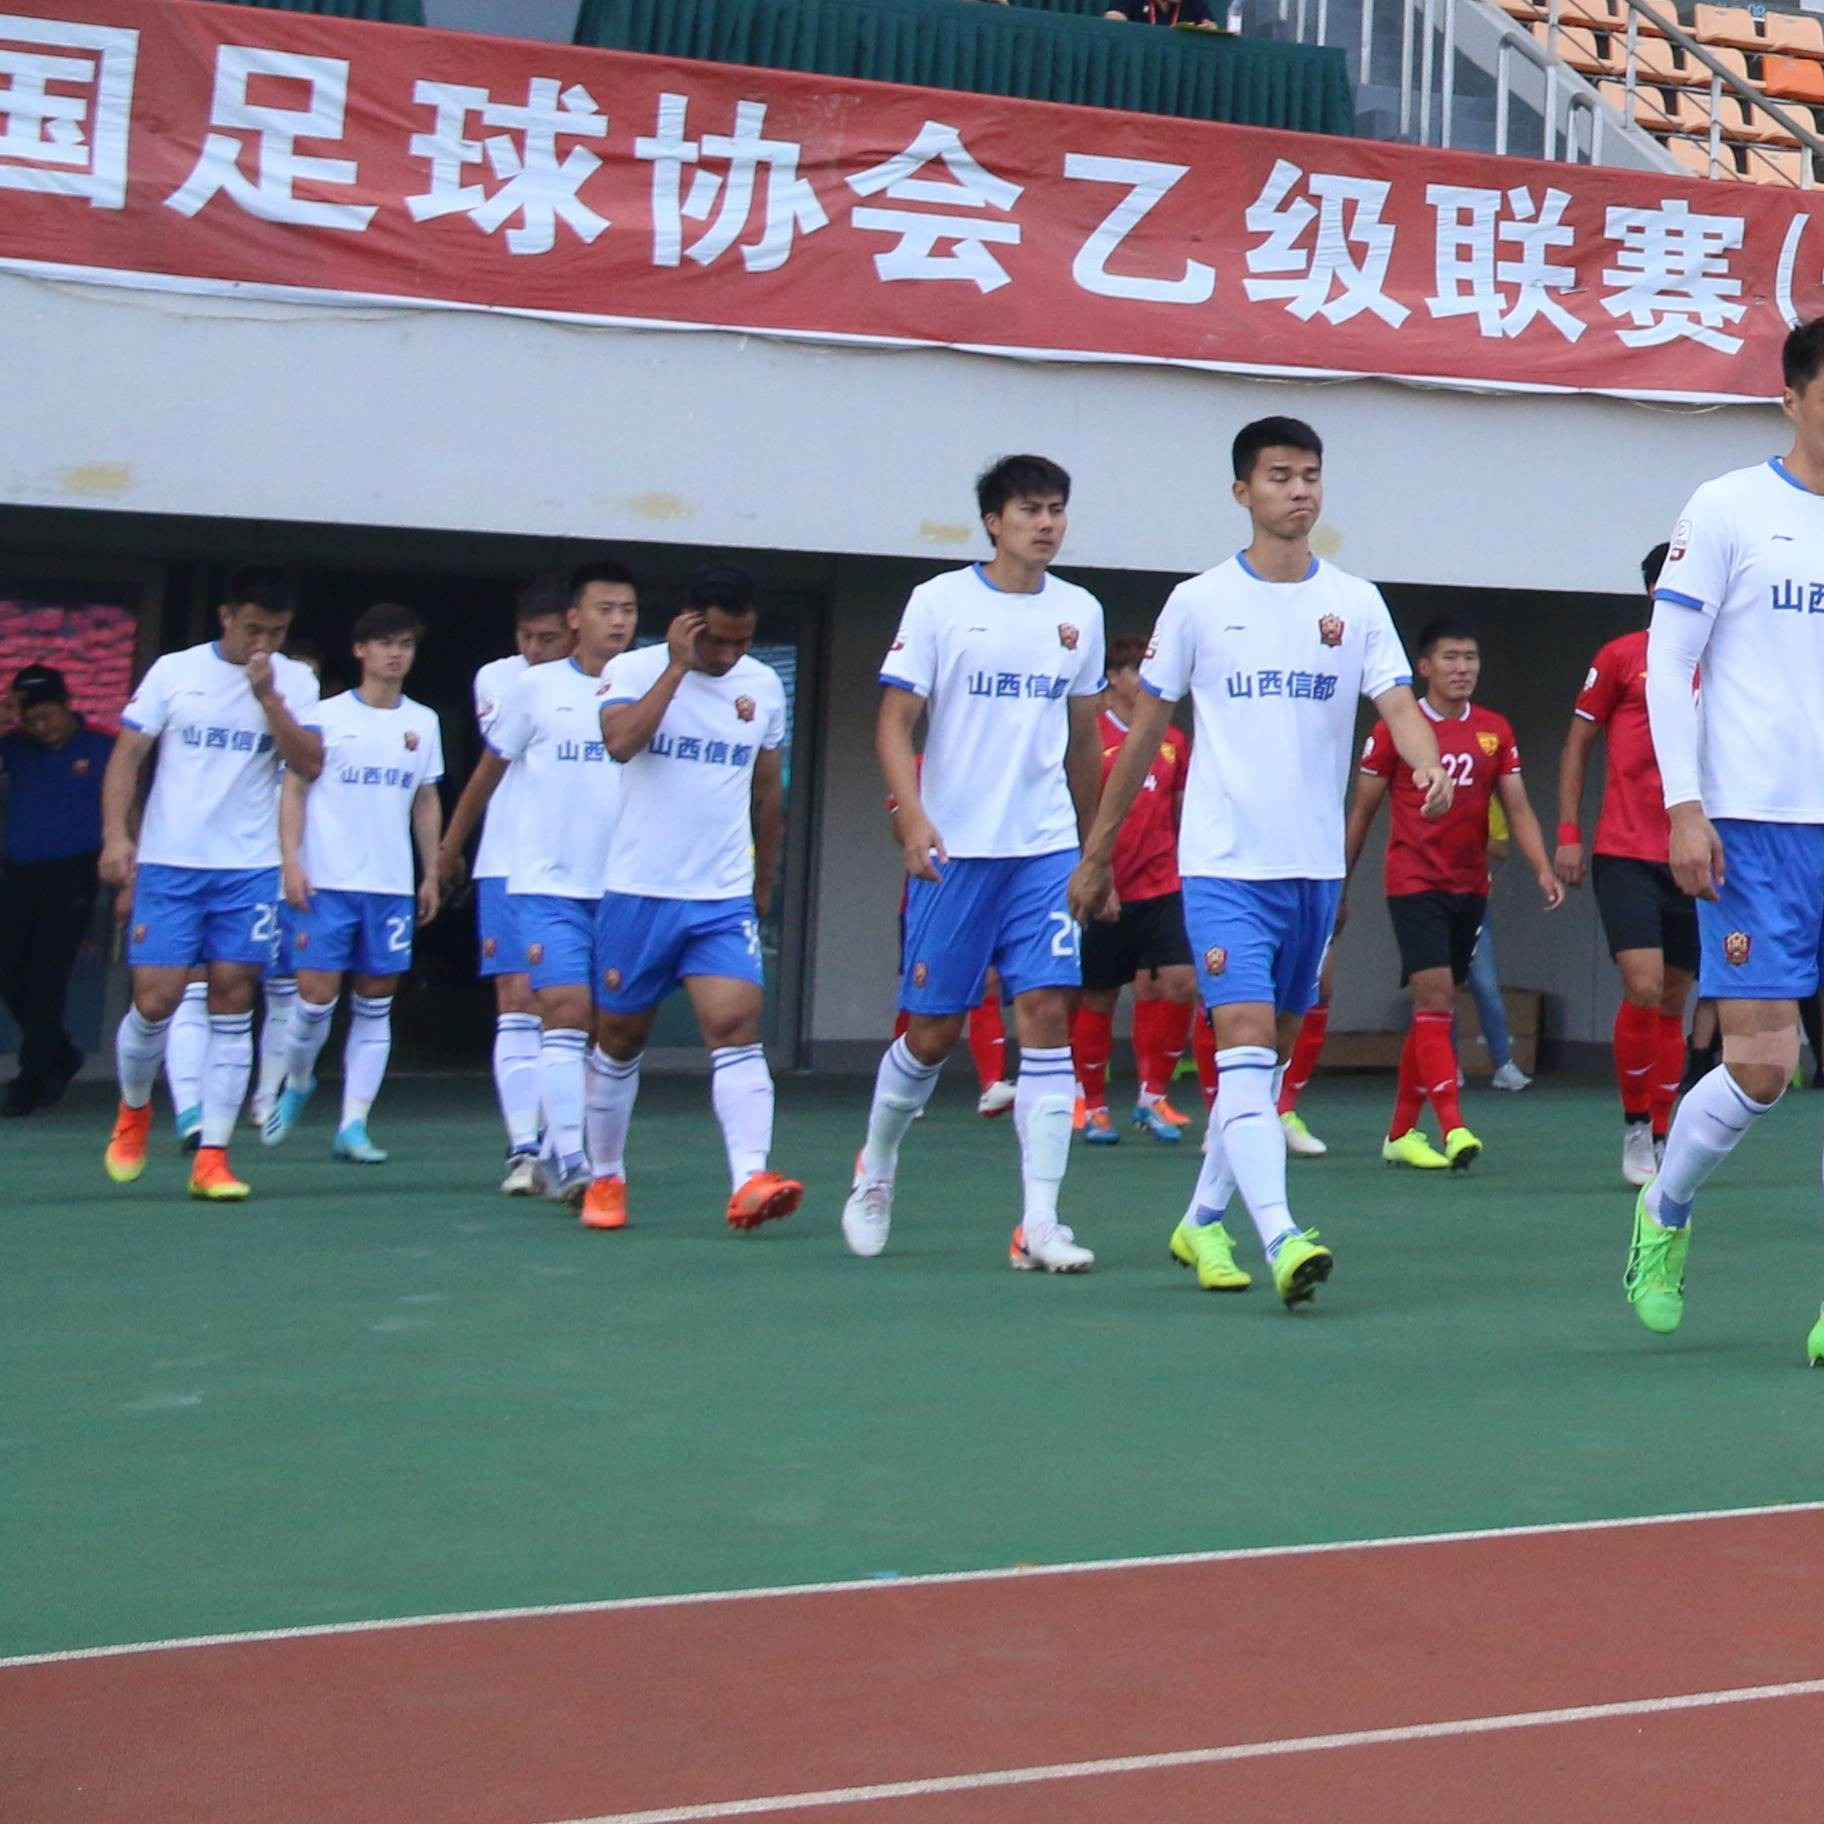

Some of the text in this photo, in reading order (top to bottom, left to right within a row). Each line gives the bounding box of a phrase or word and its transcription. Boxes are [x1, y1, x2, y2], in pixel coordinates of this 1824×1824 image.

[966, 670, 1072, 700] 山西信都
[1225, 669, 1339, 702] 山西信都
[648, 732, 755, 768] 山西信都
[1440, 751, 1474, 787] 22
[250, 902, 282, 942] 2
[386, 914, 412, 953] 2
[1049, 911, 1083, 959] 2
